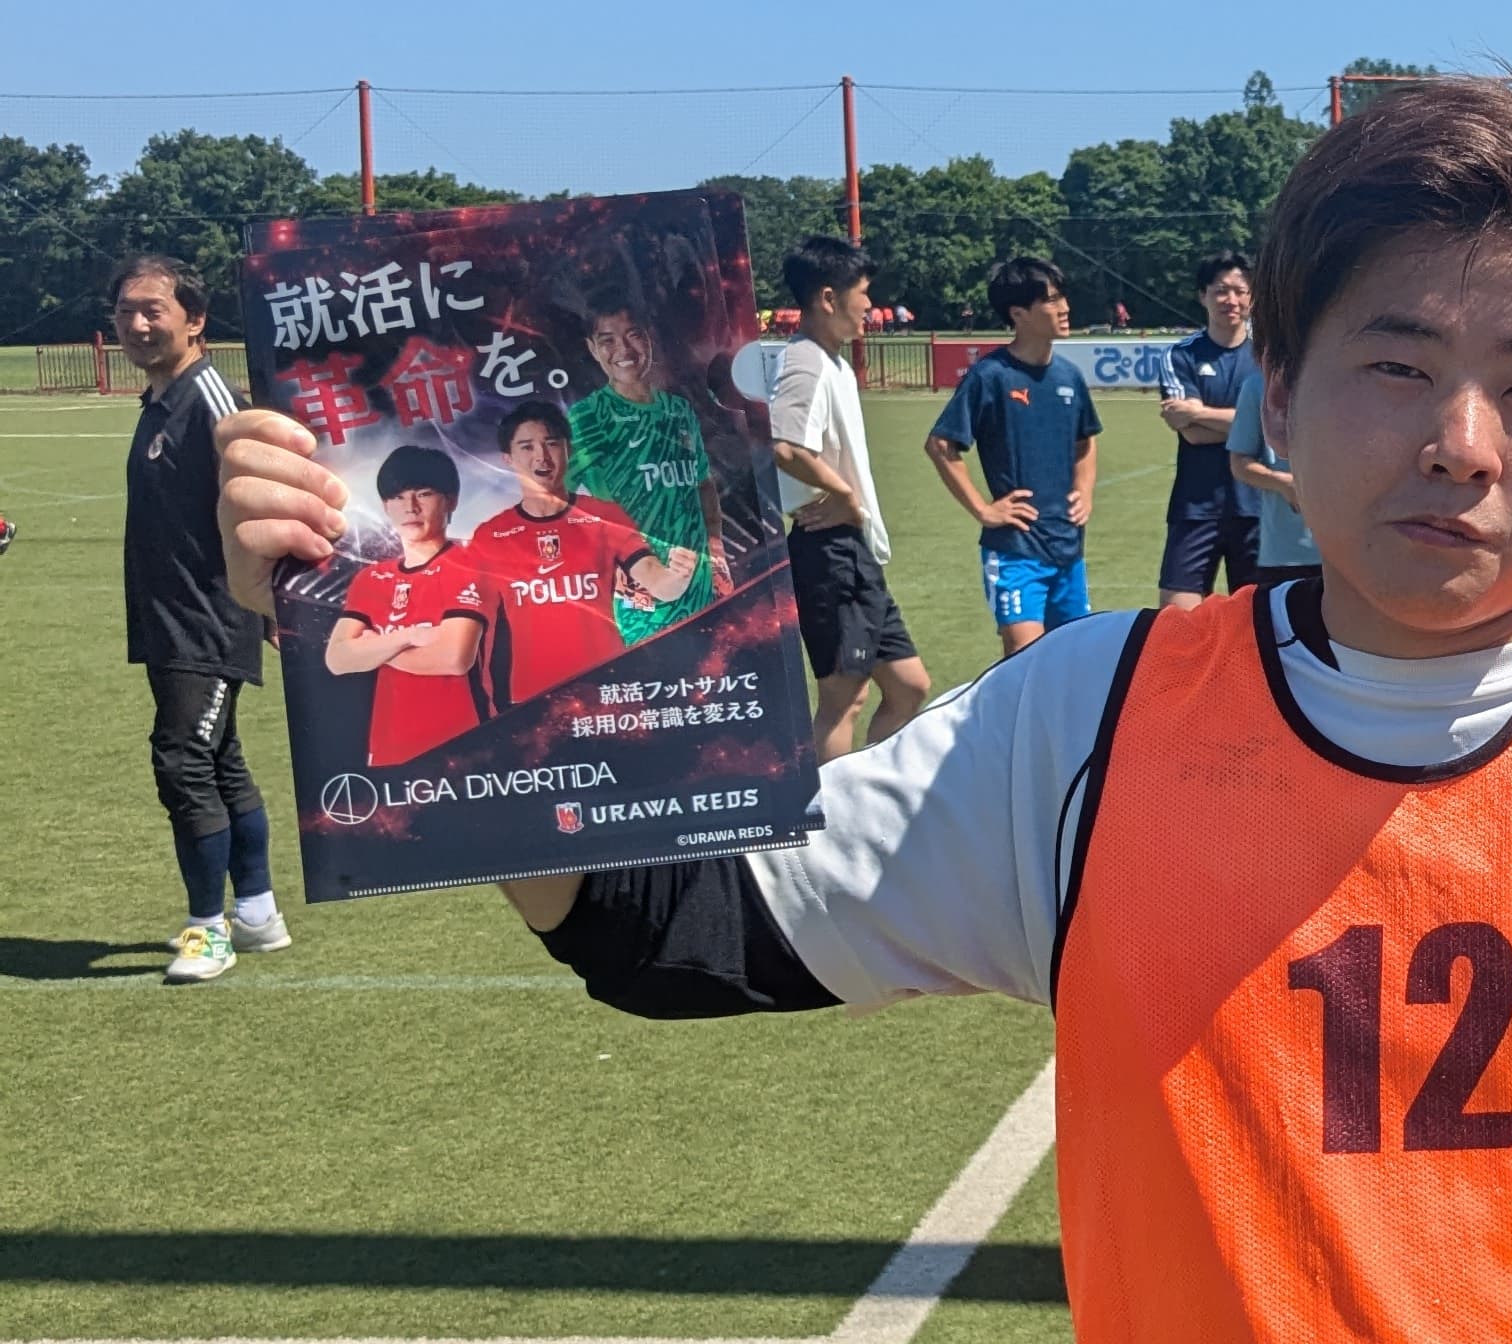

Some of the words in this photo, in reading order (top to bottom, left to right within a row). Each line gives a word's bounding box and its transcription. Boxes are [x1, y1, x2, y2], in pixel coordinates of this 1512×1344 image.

[263, 260, 485, 350] 就活に
[274, 331, 570, 446] 革命を。
[510, 573, 599, 606] POLUS
[598, 671, 760, 705] 就活フットサルで
[572, 700, 764, 738] 採用の常識を変える
[590, 798, 684, 824] URAWA
[691, 788, 760, 812] REDS
[737, 824, 774, 840] REDS
